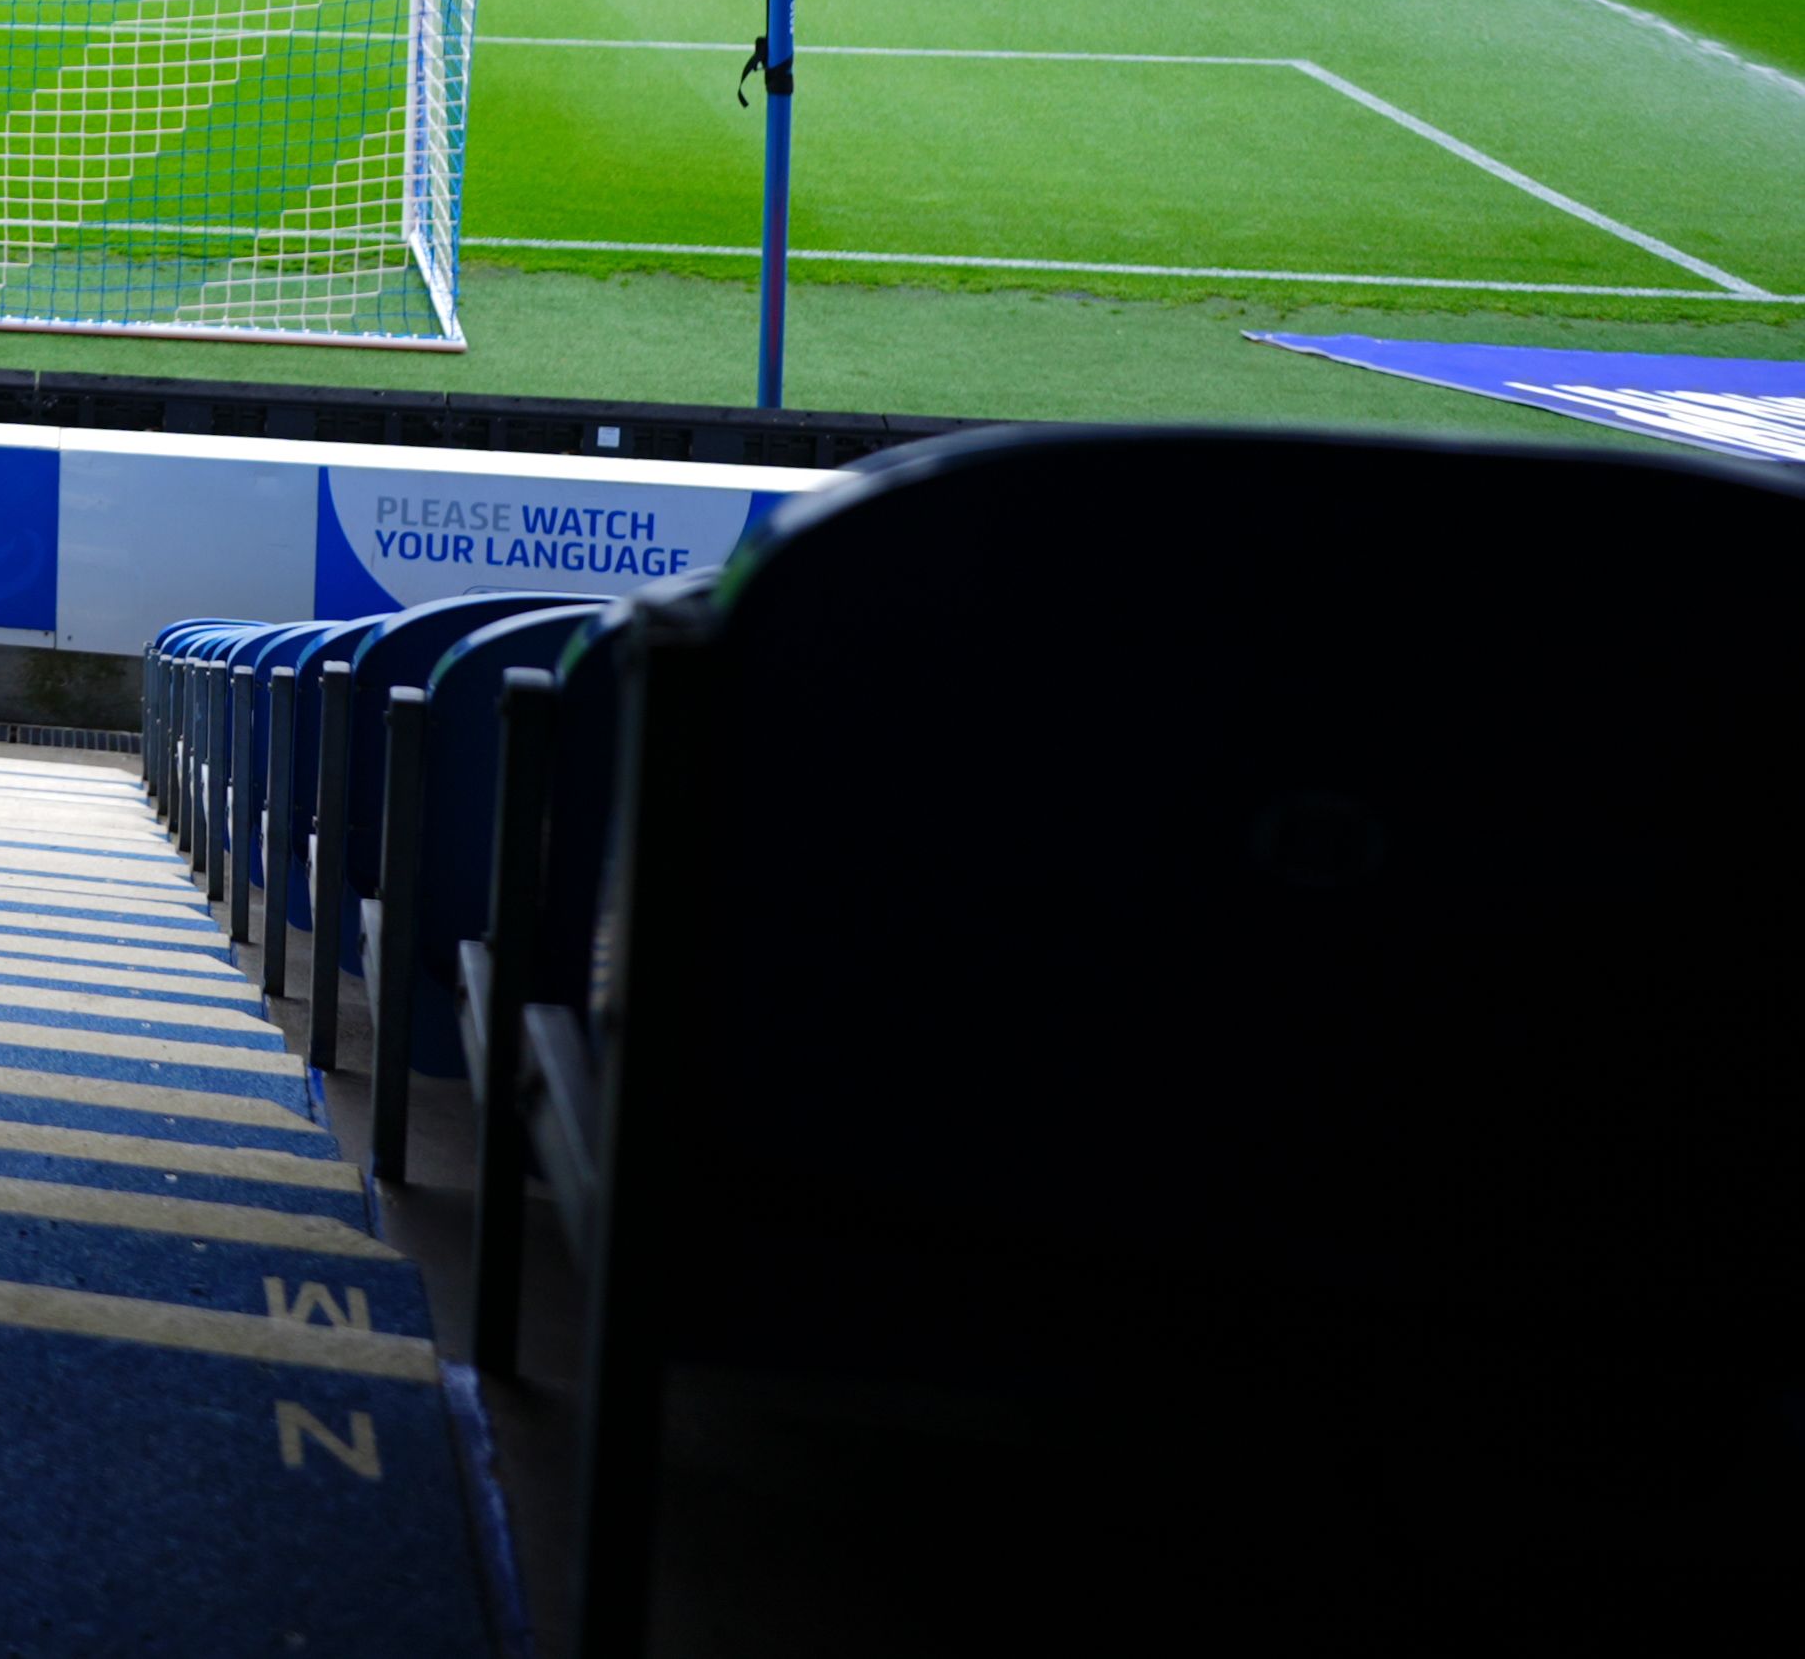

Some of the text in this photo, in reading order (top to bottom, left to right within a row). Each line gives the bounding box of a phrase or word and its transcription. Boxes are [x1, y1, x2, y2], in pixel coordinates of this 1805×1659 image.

[375, 496, 656, 542] PLEASE WATCH
[374, 529, 691, 577] YOUR LANGUAGE
[274, 1397, 384, 1483] N
